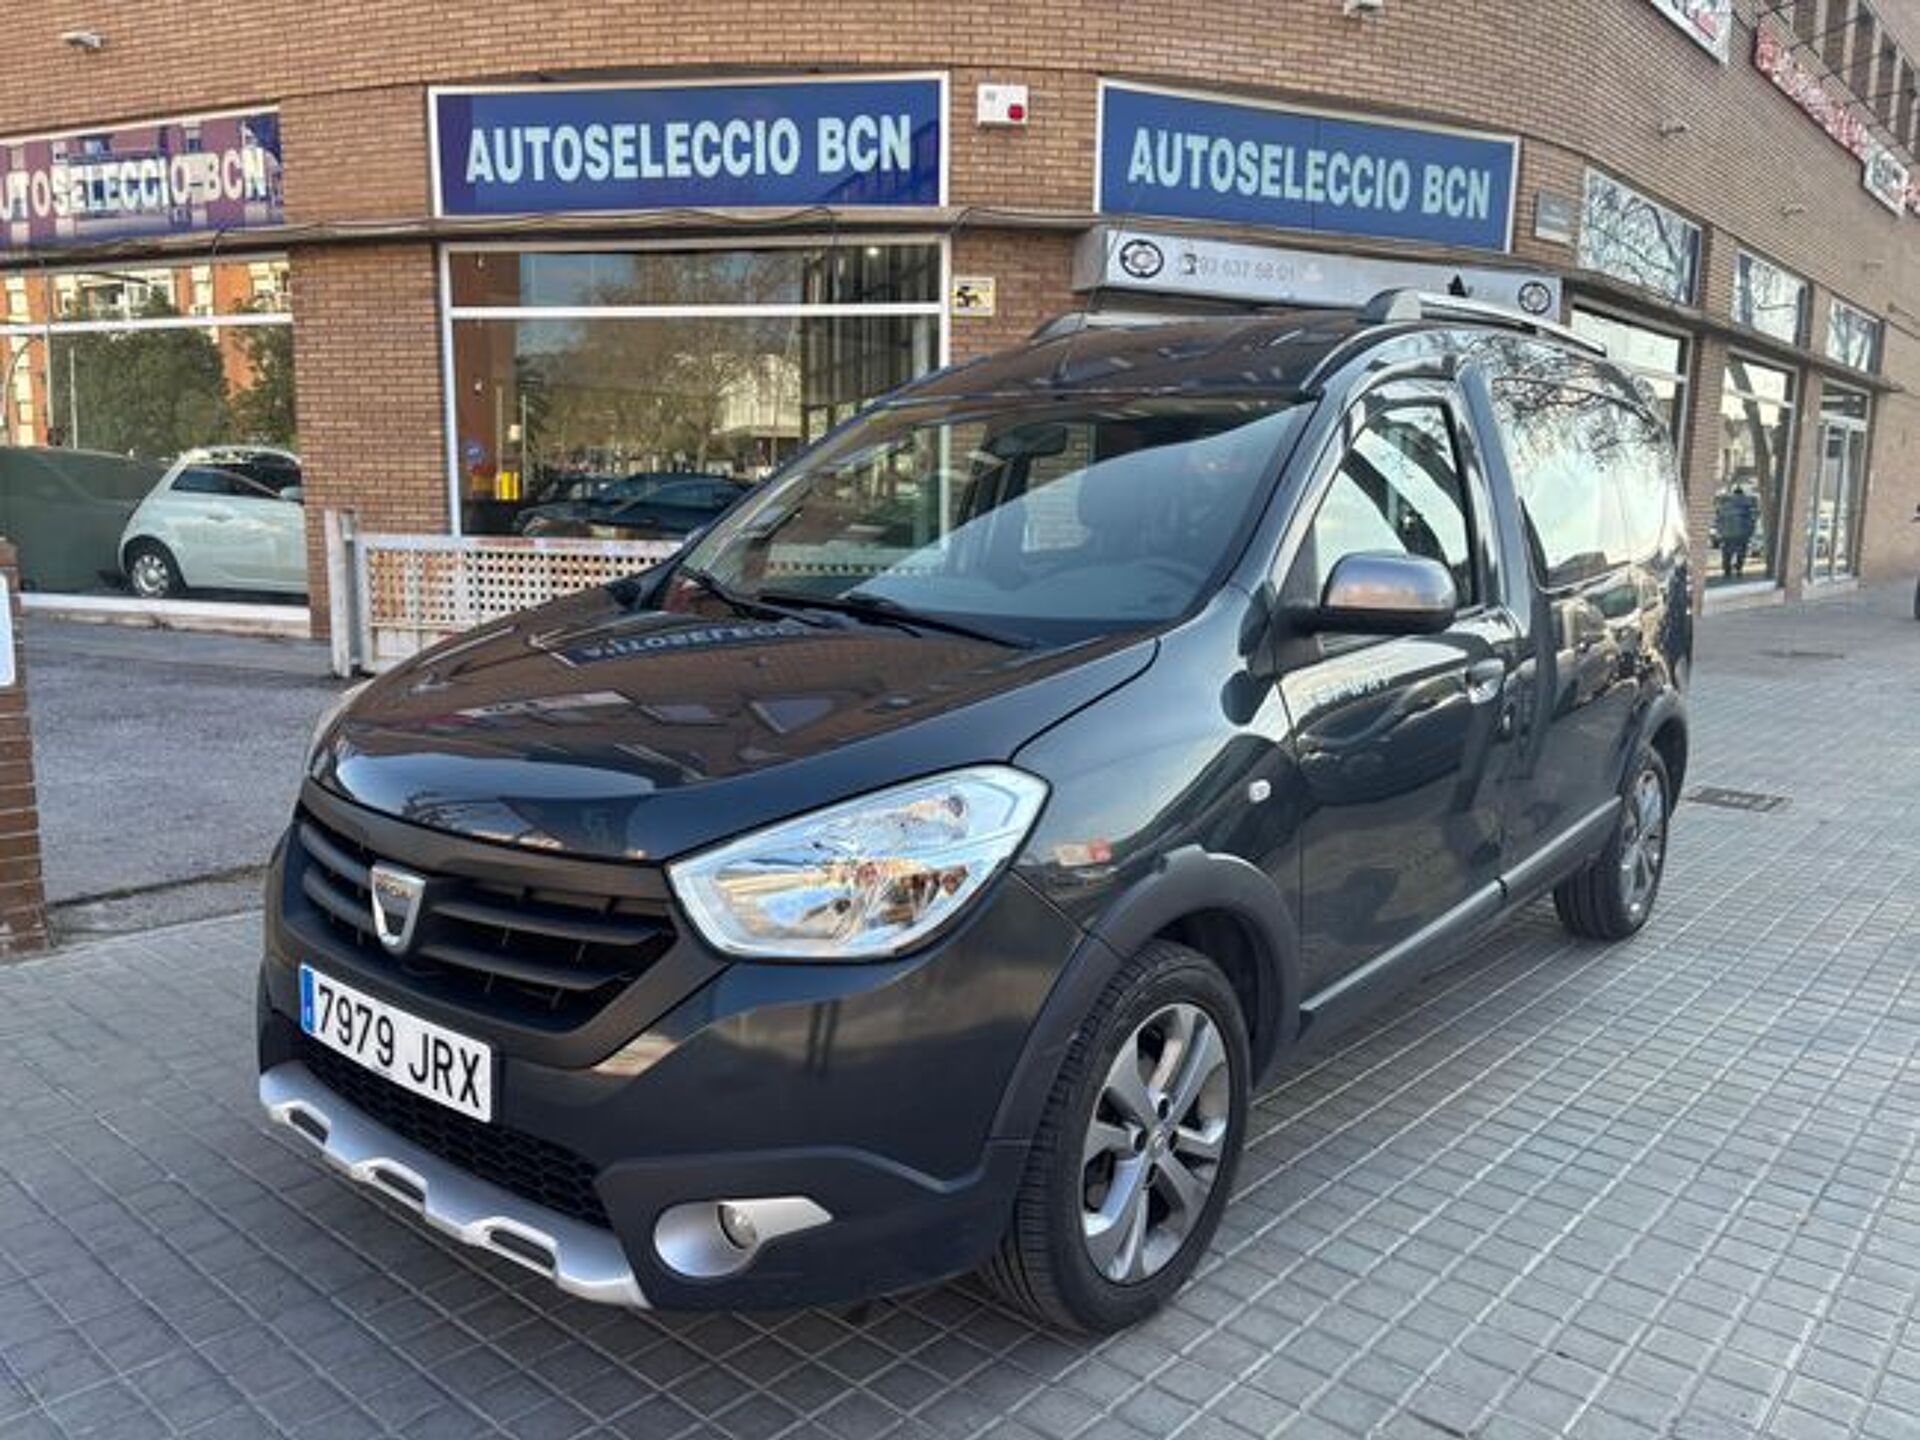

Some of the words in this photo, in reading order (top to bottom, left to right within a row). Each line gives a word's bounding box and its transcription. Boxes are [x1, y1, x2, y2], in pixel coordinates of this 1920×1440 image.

[203, 146, 267, 203] BCN
[466, 118, 800, 183] AUTOSELECCIO
[817, 113, 911, 173] BCN
[1127, 127, 1411, 213] AUTOSELECCIO
[1421, 163, 1490, 220] BCN
[317, 982, 395, 1068] 7979
[408, 1032, 480, 1109] JRX
